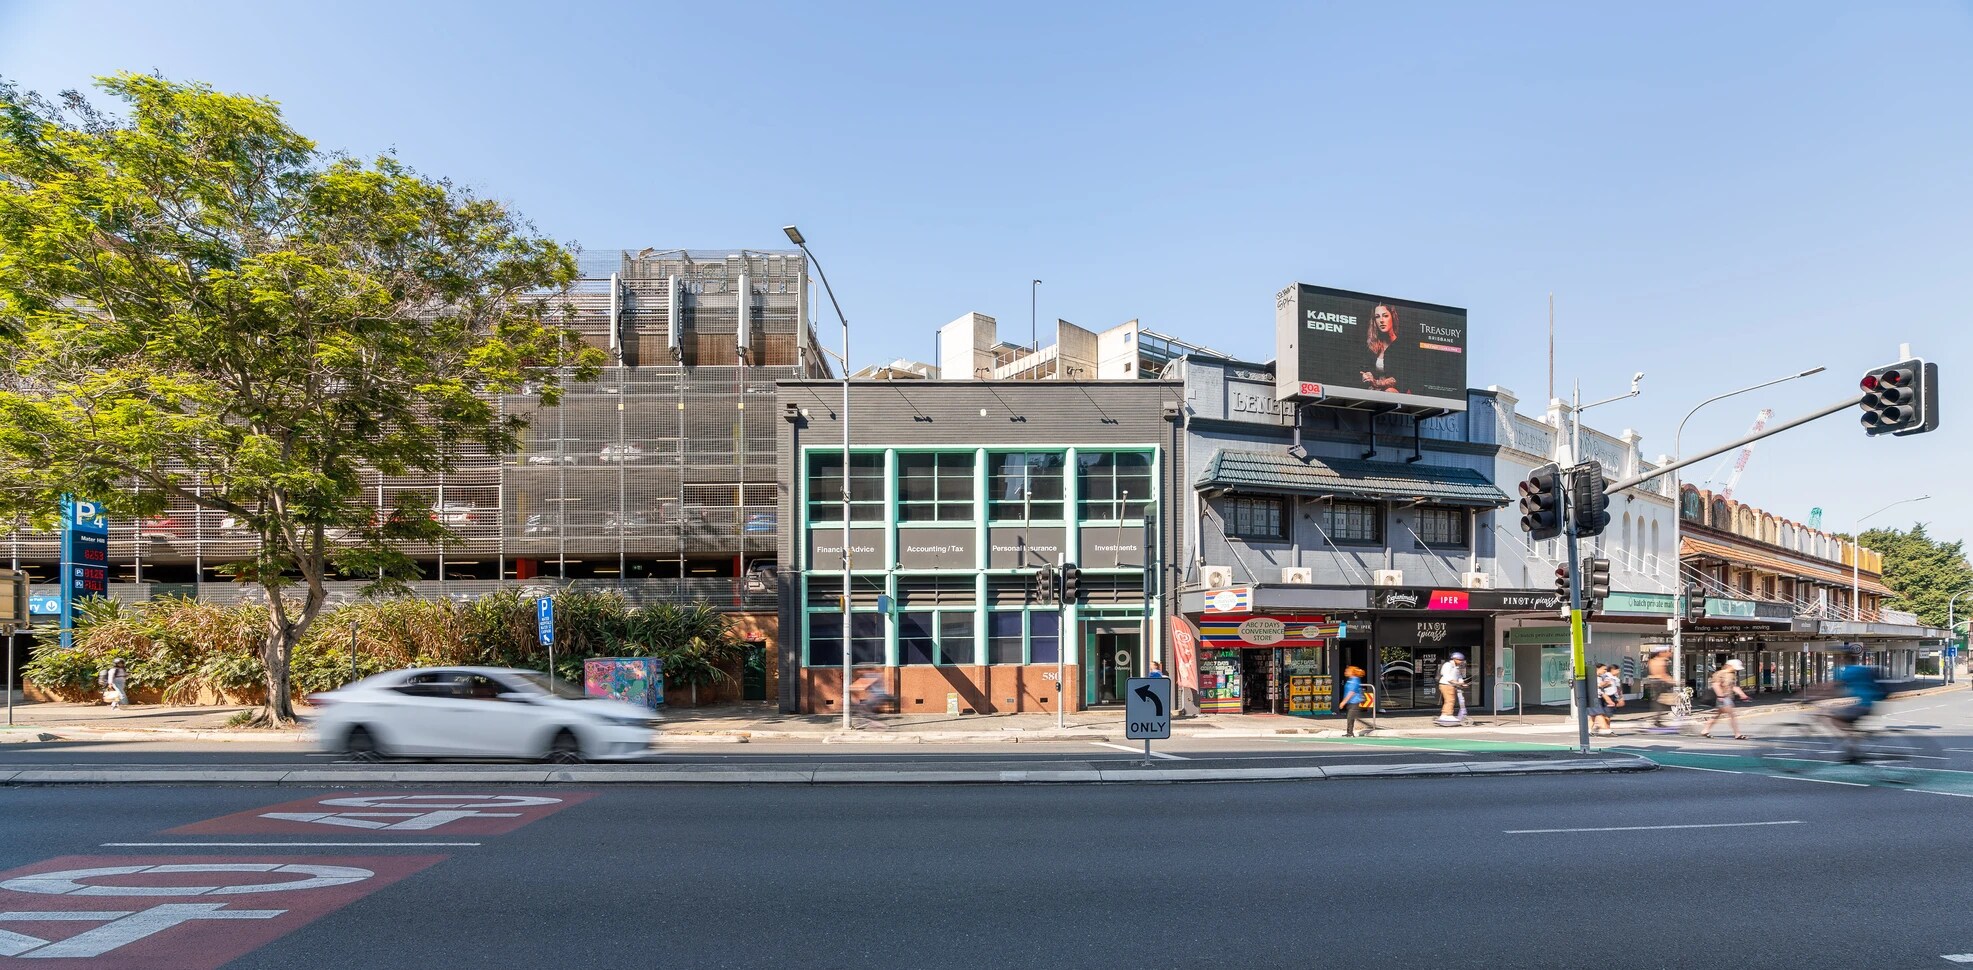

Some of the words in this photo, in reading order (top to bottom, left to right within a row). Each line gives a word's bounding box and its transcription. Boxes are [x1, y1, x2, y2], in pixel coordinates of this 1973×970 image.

[1307, 310, 1357, 325] KARISE
[1307, 320, 1343, 333] EDEN
[1420, 323, 1461, 338] TREASURY
[1301, 383, 1320, 394] goa
[81, 535, 96, 543] Mater
[1503, 597, 1530, 605] PINOT
[542, 600, 548, 617] P
[1417, 622, 1446, 630] PINOT
[1042, 672, 1060, 681] 580
[1131, 722, 1166, 732] ONLY
